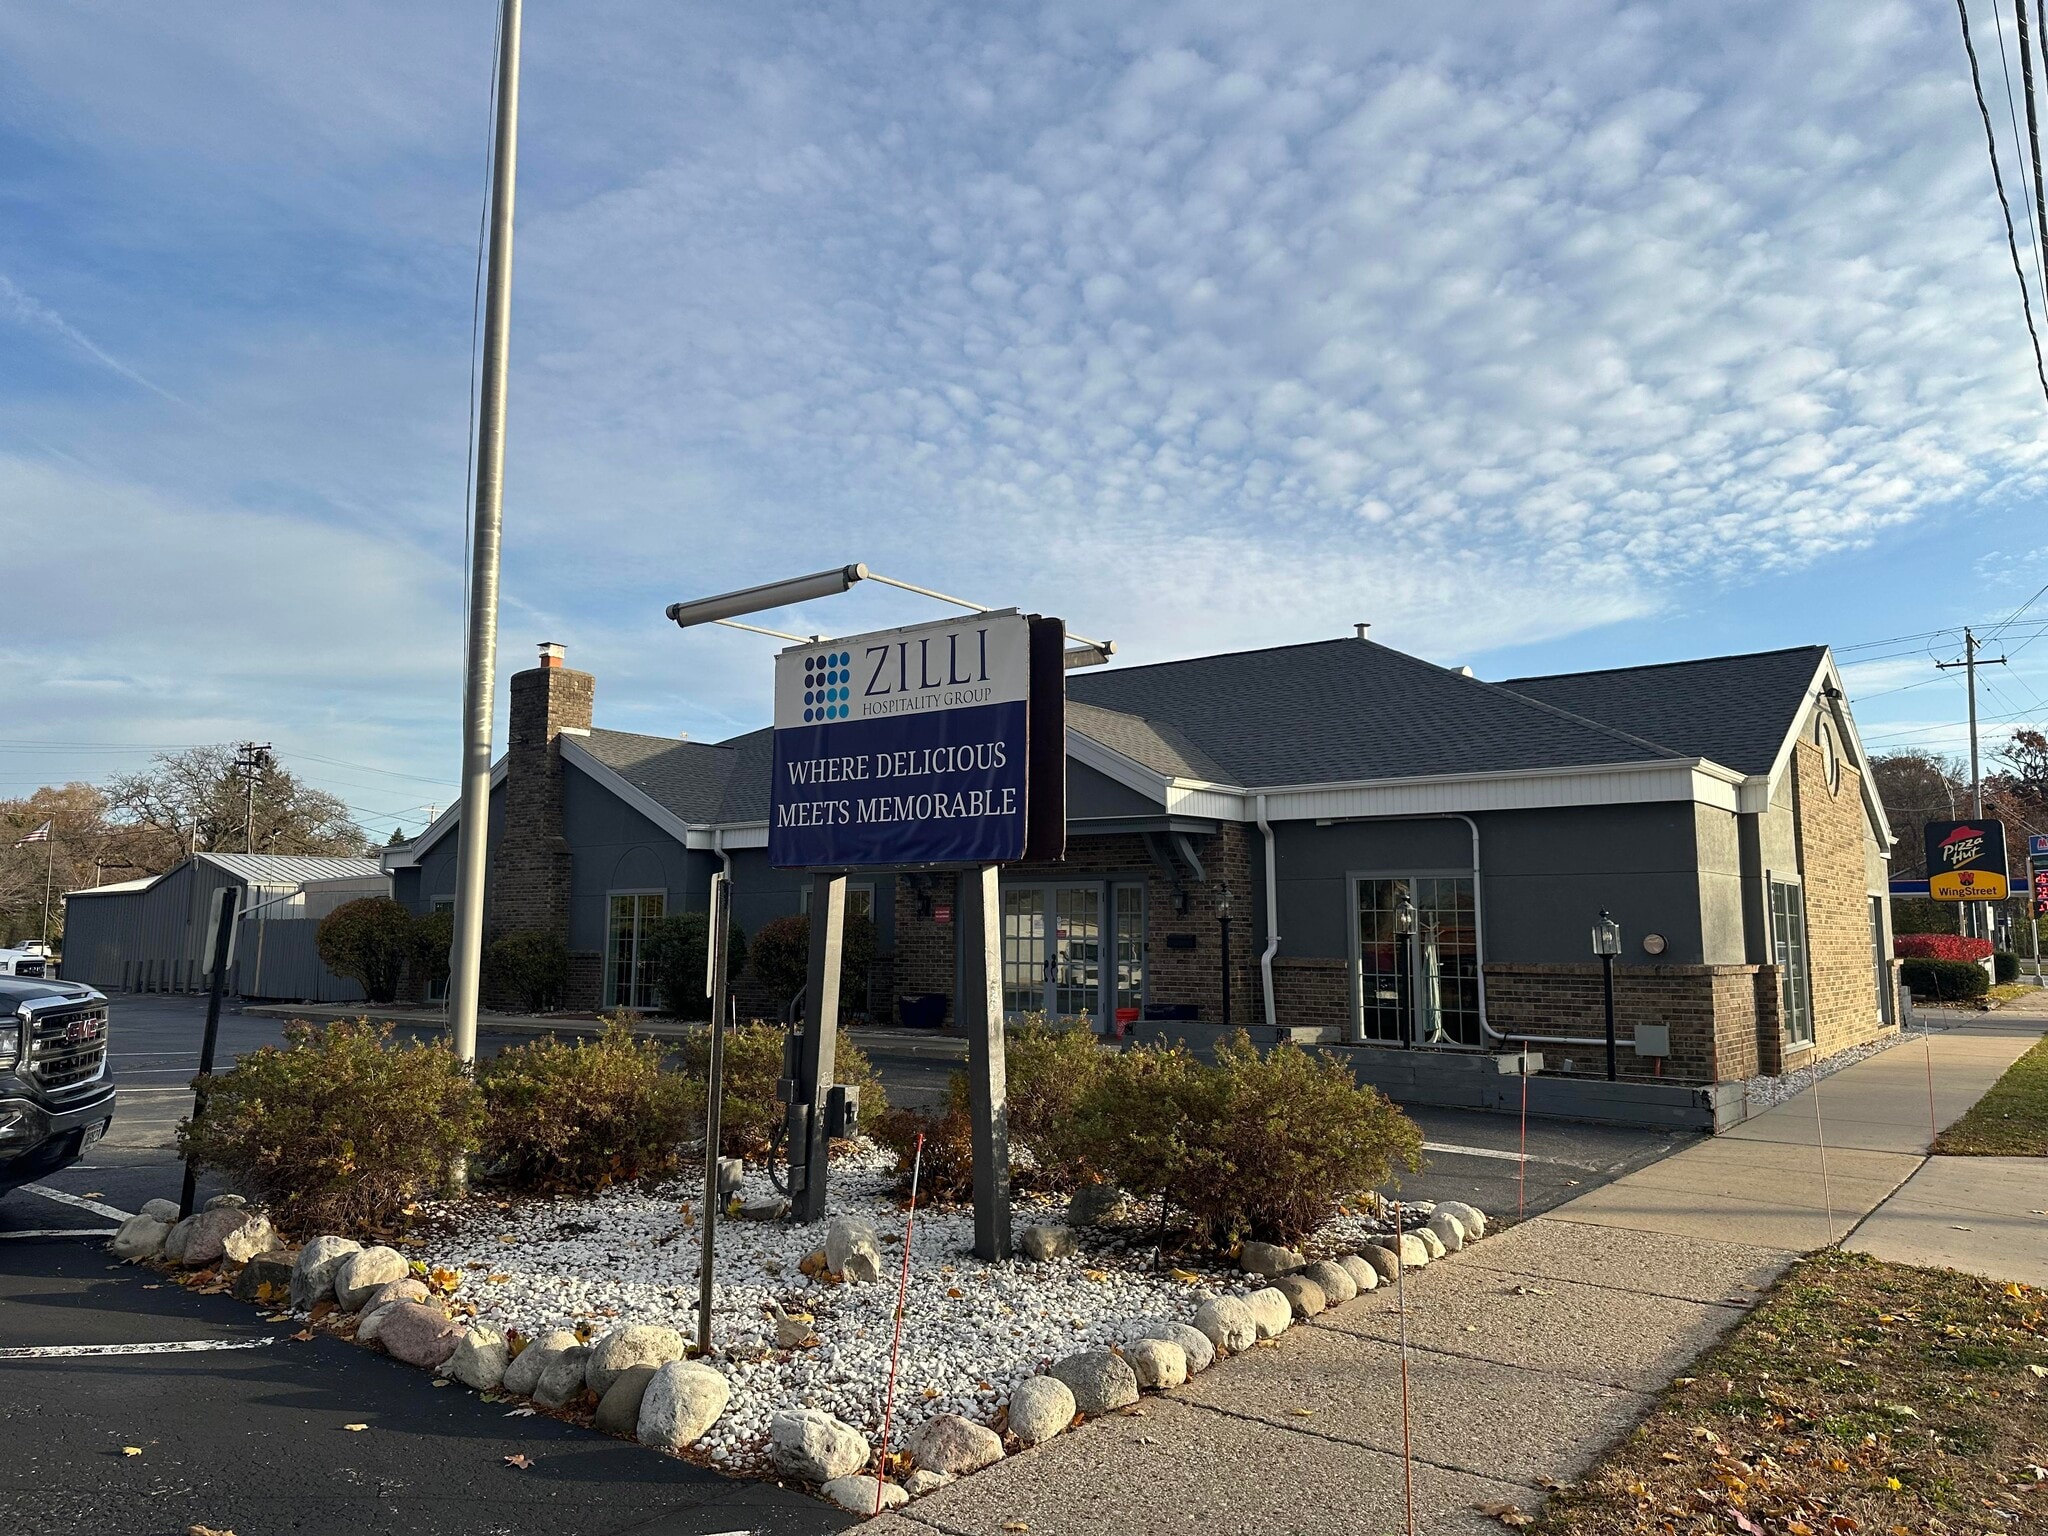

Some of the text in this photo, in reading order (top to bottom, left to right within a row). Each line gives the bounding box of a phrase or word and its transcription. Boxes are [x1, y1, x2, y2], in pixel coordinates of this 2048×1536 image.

[864, 628, 990, 696] ZILLI
[863, 687, 992, 716] HOSPITALITY GROUP
[787, 741, 1007, 785] WHERE DELICIOUS
[777, 787, 1017, 828] MEETS MEMORABLE
[1943, 837, 1983, 861] Pizza
[1952, 846, 1980, 864] Hut
[1938, 886, 1997, 897] WingStreet
[66, 1018, 98, 1040] GMC
